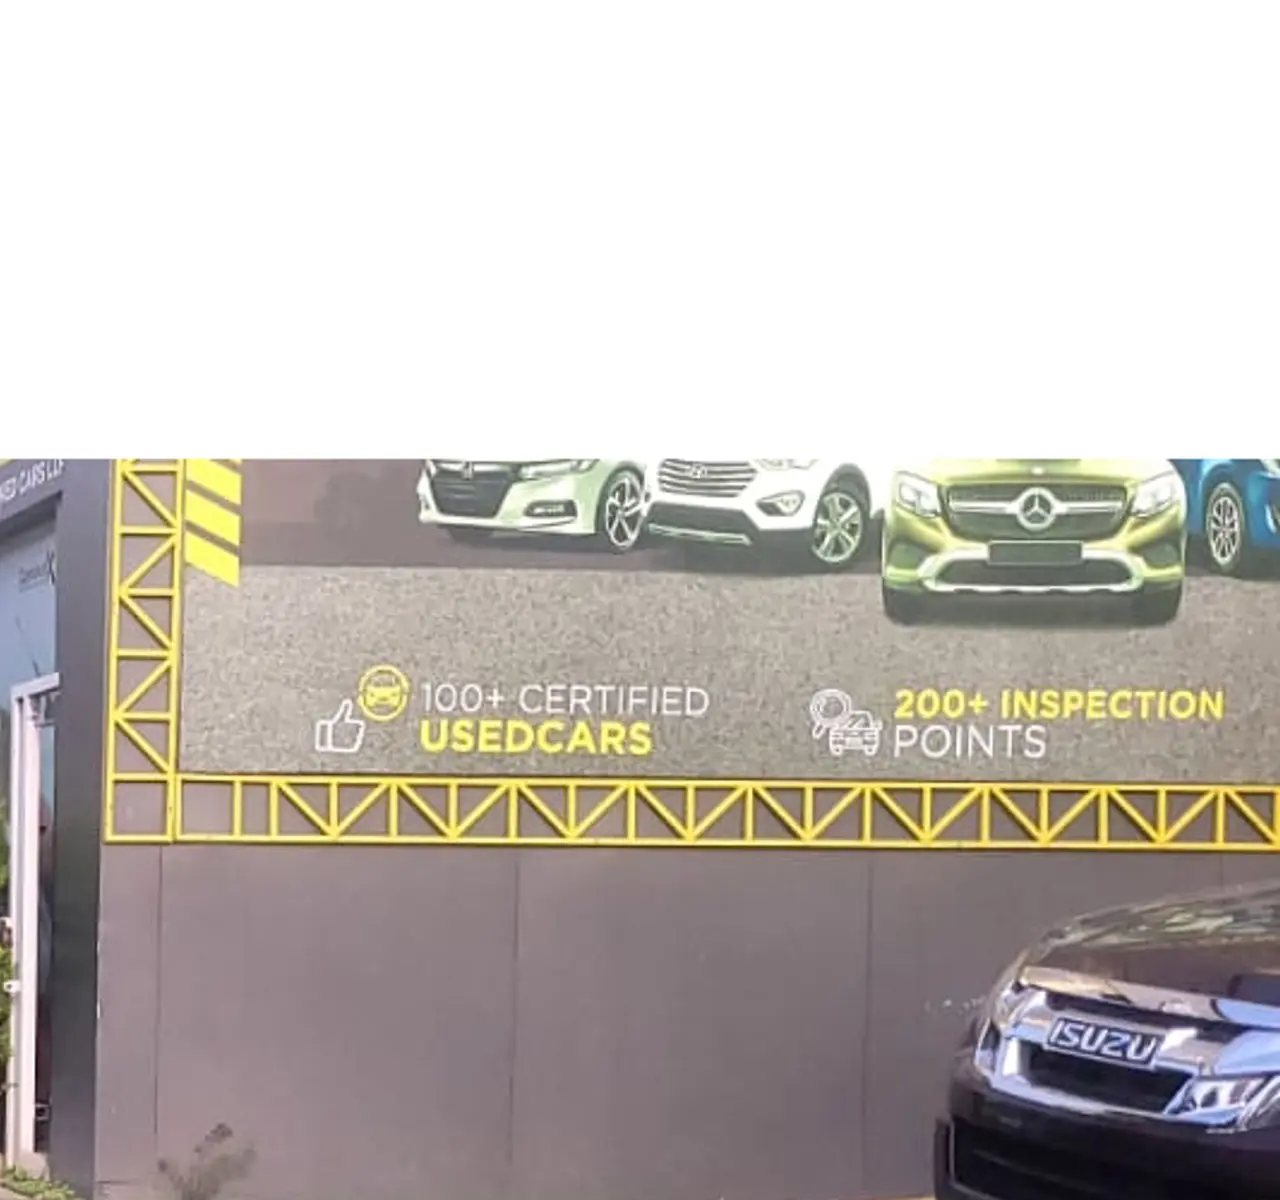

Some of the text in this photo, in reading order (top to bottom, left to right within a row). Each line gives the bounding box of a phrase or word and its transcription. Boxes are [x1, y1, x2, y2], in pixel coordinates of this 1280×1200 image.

[421, 682, 711, 717] 100+ CERTIFIED
[894, 687, 1225, 721] 200+ INSPECTION
[419, 718, 653, 756] USEDCARS
[893, 724, 1048, 760] POINTS
[1050, 1019, 1158, 1061] ISUZU
